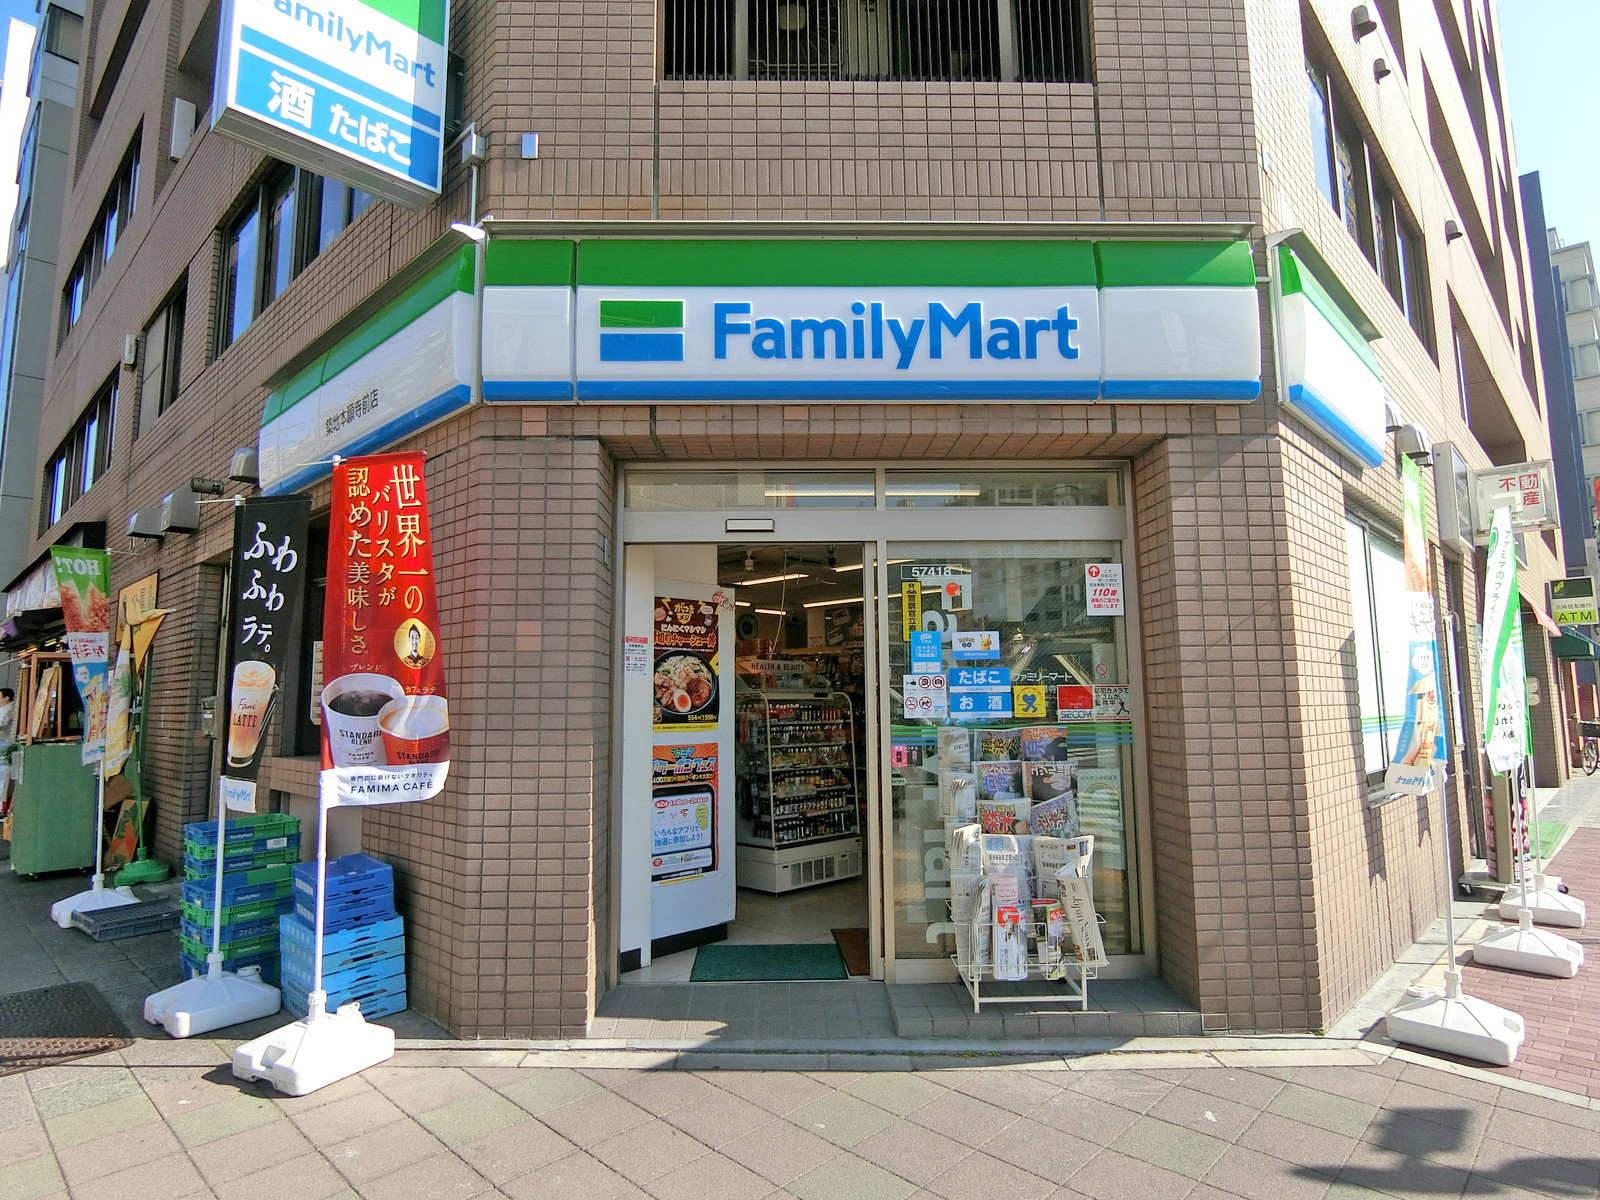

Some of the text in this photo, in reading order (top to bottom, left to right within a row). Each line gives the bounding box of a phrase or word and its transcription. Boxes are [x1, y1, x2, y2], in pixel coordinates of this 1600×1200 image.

[257, 0, 436, 88] amilyMart
[267, 70, 411, 166] 酒 たばこ
[713, 301, 1080, 370] FamilyMart
[325, 388, 379, 437] 築地本願寺前店
[372, 485, 396, 606] バリスタが
[389, 464, 429, 614] 世界一の
[911, 566, 952, 578] 57418
[1093, 588, 1118, 597] 110番
[907, 595, 917, 640] 警察官立寄
[1558, 611, 1592, 622] ATM
[350, 663, 382, 671] ブレンド
[751, 662, 775, 671] HEALTH
[783, 663, 805, 671] BEAUTY
[959, 670, 1001, 684] たばこ
[1012, 672, 1072, 682] ファミリーマート
[405, 685, 438, 694] カフェラテ
[959, 695, 1003, 710] お酒
[233, 713, 258, 728] LATTE
[1060, 710, 1093, 719] SECOM
[350, 771, 434, 782] 専門店に負けないクオリティ
[351, 779, 433, 794] FAMIMA CAFÉ
